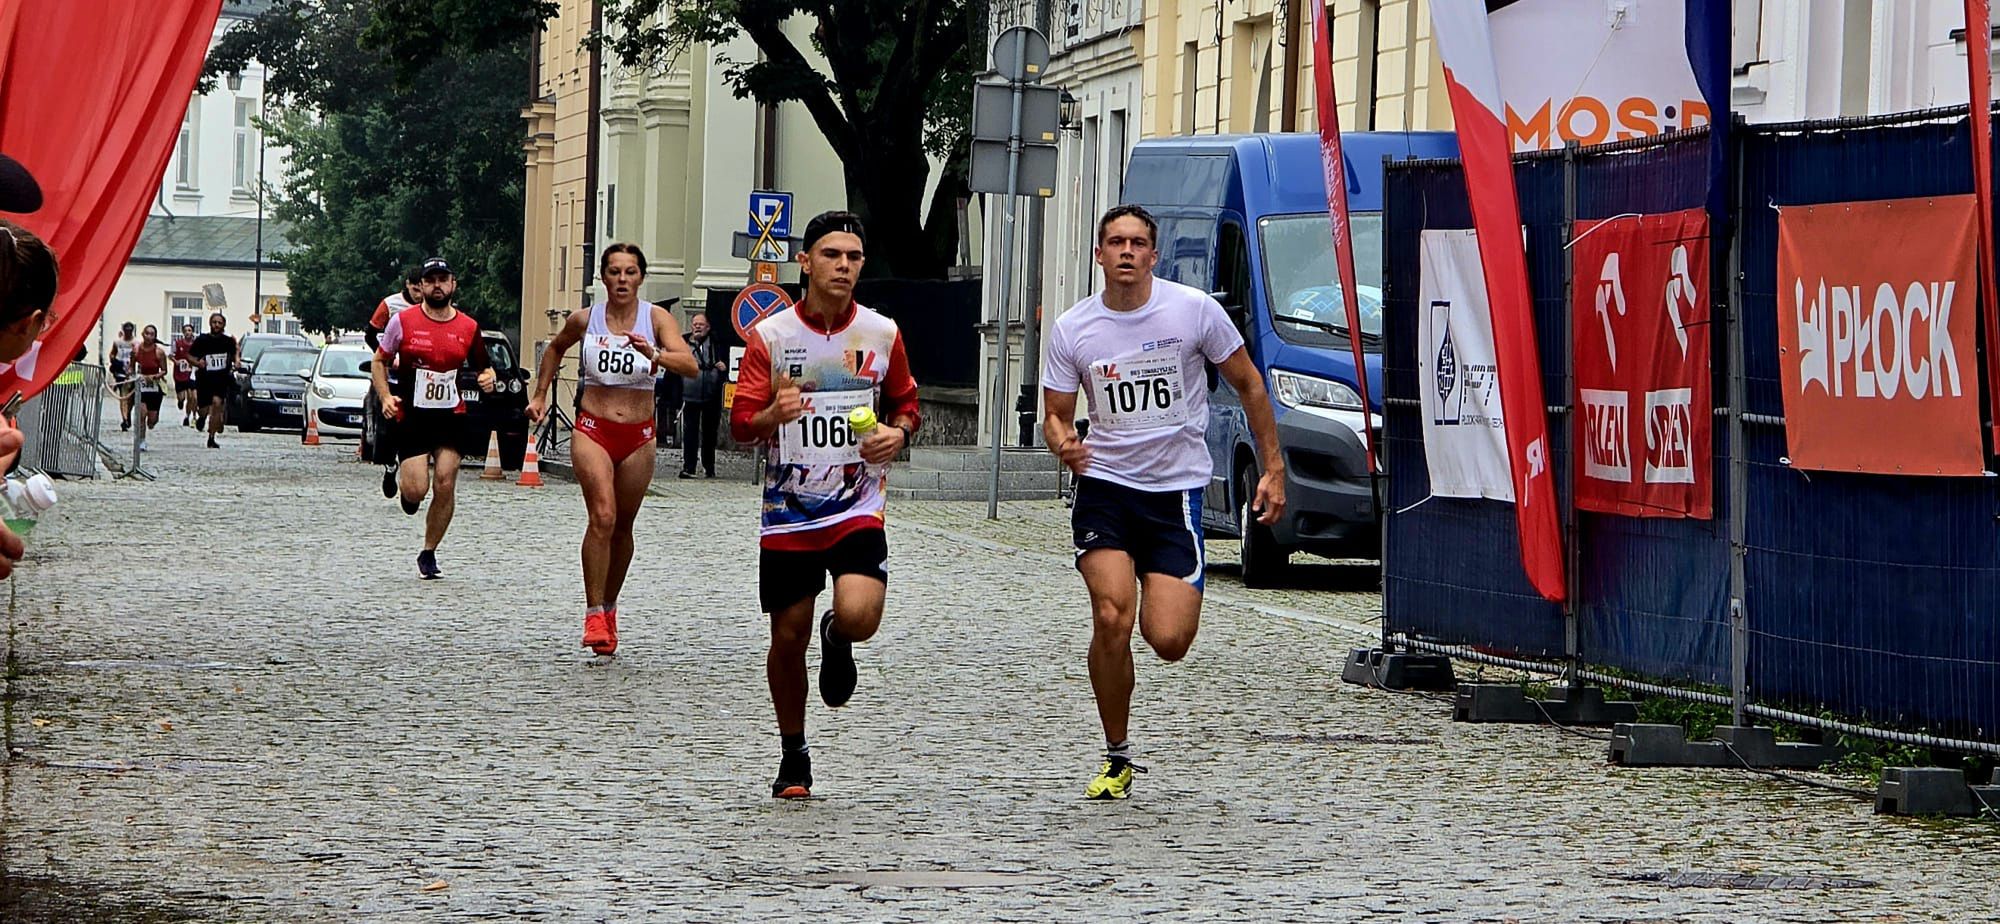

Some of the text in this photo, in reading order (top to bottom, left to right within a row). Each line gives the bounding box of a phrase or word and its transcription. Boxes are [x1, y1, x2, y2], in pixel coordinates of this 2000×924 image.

[1831, 281, 1961, 400] PŁOCK
[598, 350, 635, 375] 858
[426, 383, 451, 401] 801
[1104, 378, 1171, 414] 1076
[581, 417, 597, 429] POL
[1582, 402, 1627, 468] RLEN
